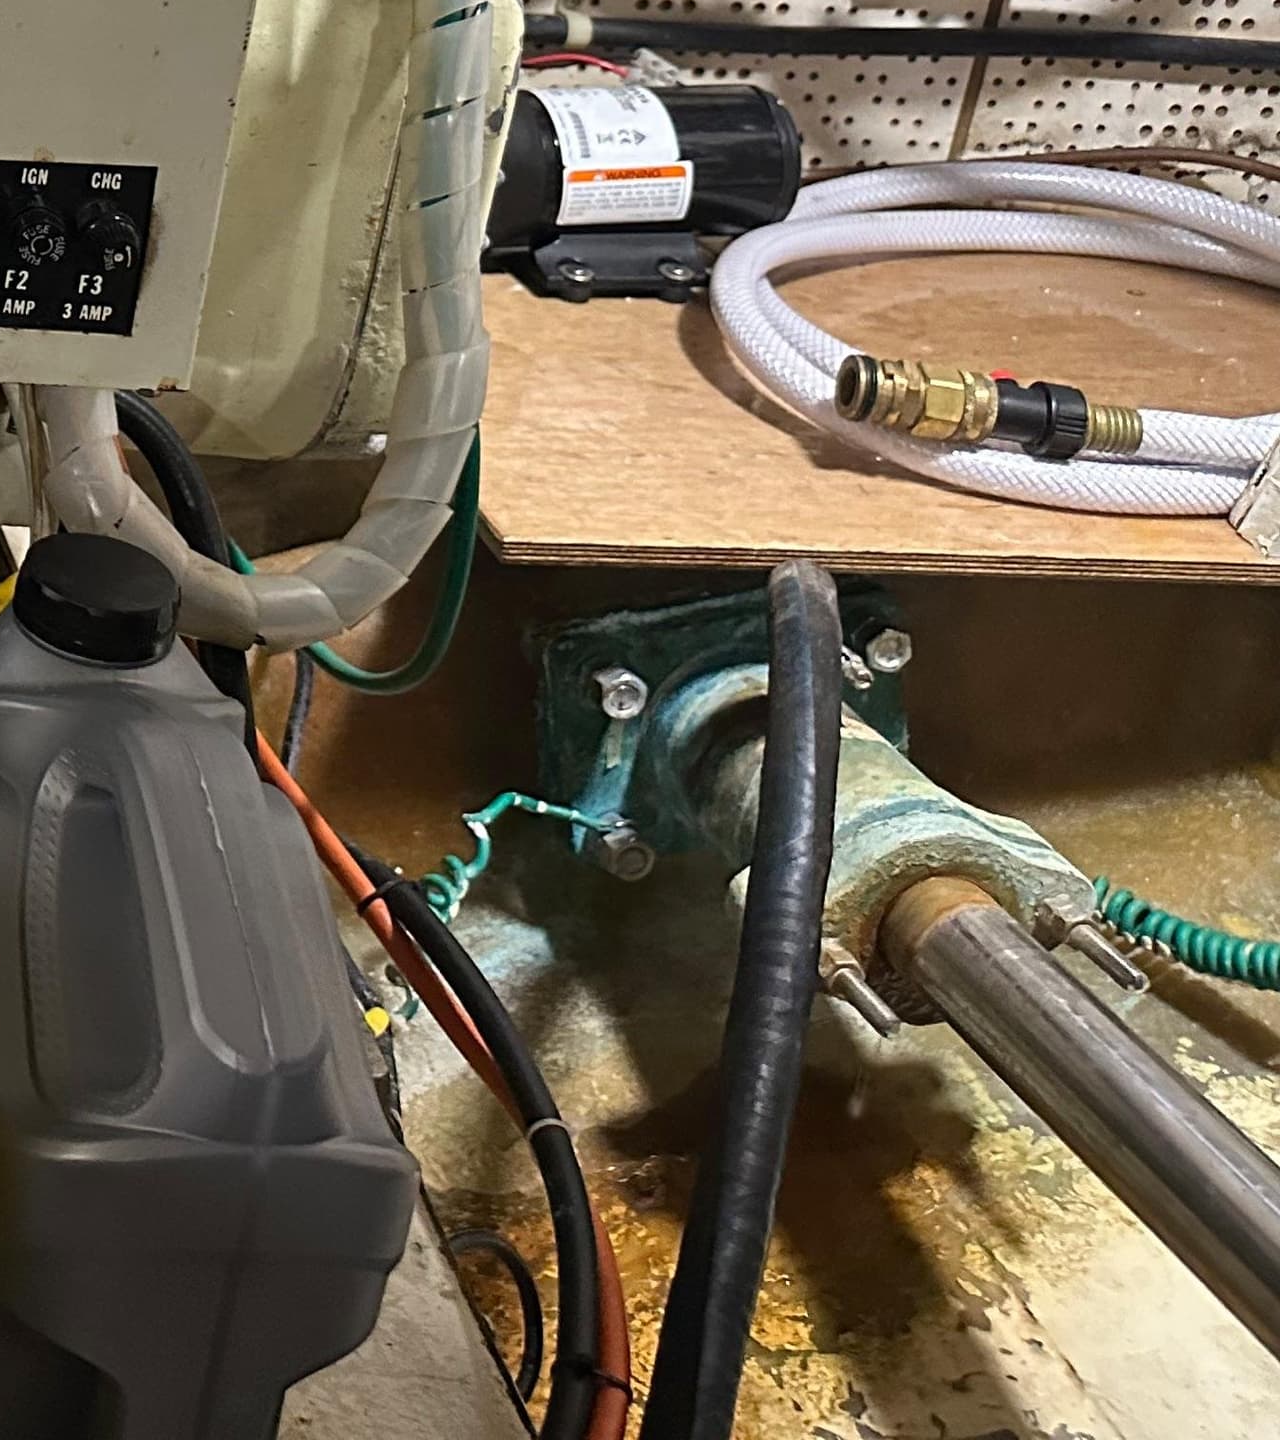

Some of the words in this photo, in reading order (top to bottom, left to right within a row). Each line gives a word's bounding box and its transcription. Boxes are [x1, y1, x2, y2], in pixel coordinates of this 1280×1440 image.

[21, 168, 49, 185] IGN
[91, 172, 122, 191] CHG
[605, 168, 662, 181] WARNING
[23, 224, 50, 241] FUSE
[4, 270, 29, 290] F2
[78, 274, 103, 296] F3
[3, 299, 36, 315] AMP
[62, 303, 72, 319] 3
[80, 305, 113, 322] AMP
